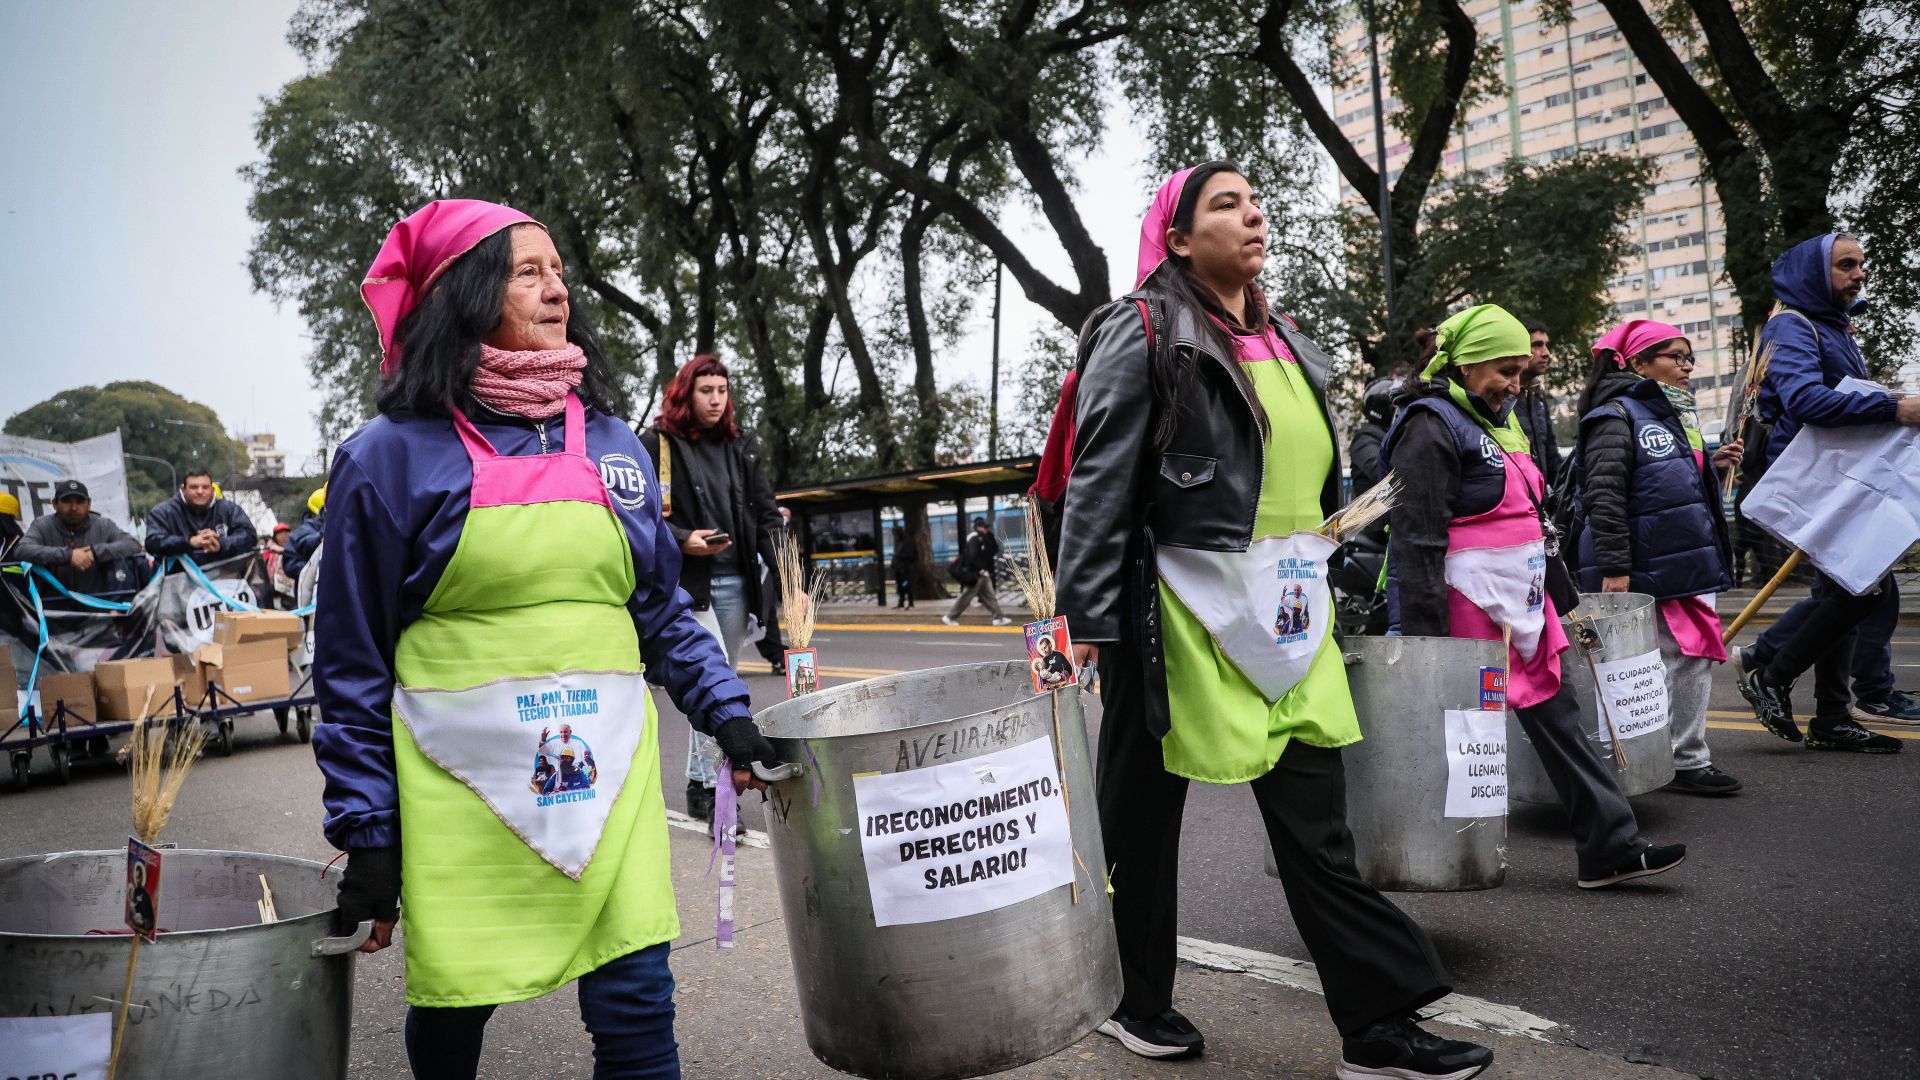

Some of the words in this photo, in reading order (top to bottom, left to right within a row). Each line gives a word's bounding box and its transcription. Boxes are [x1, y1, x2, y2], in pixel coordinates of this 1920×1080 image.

[1639, 433, 1674, 449] UTEP
[1607, 674, 1617, 682] EL
[1619, 666, 1651, 680] CUIDADO
[1634, 678, 1653, 690] AMOR
[516, 694, 540, 709] PAZ,
[541, 691, 565, 706] PAN,
[566, 688, 598, 703] TIERRA
[518, 706, 551, 722] TECHO
[552, 705, 560, 718] Y
[561, 702, 599, 717] TRABAJO
[1630, 703, 1660, 717] TRABAJO
[1459, 742, 1481, 755] LAS
[536, 795, 555, 807] SAN
[555, 788, 596, 804] CAYETANO
[899, 818, 1020, 863] DERECHOS
[1025, 812, 1037, 834] Y
[924, 847, 1028, 890] SALARIO!
